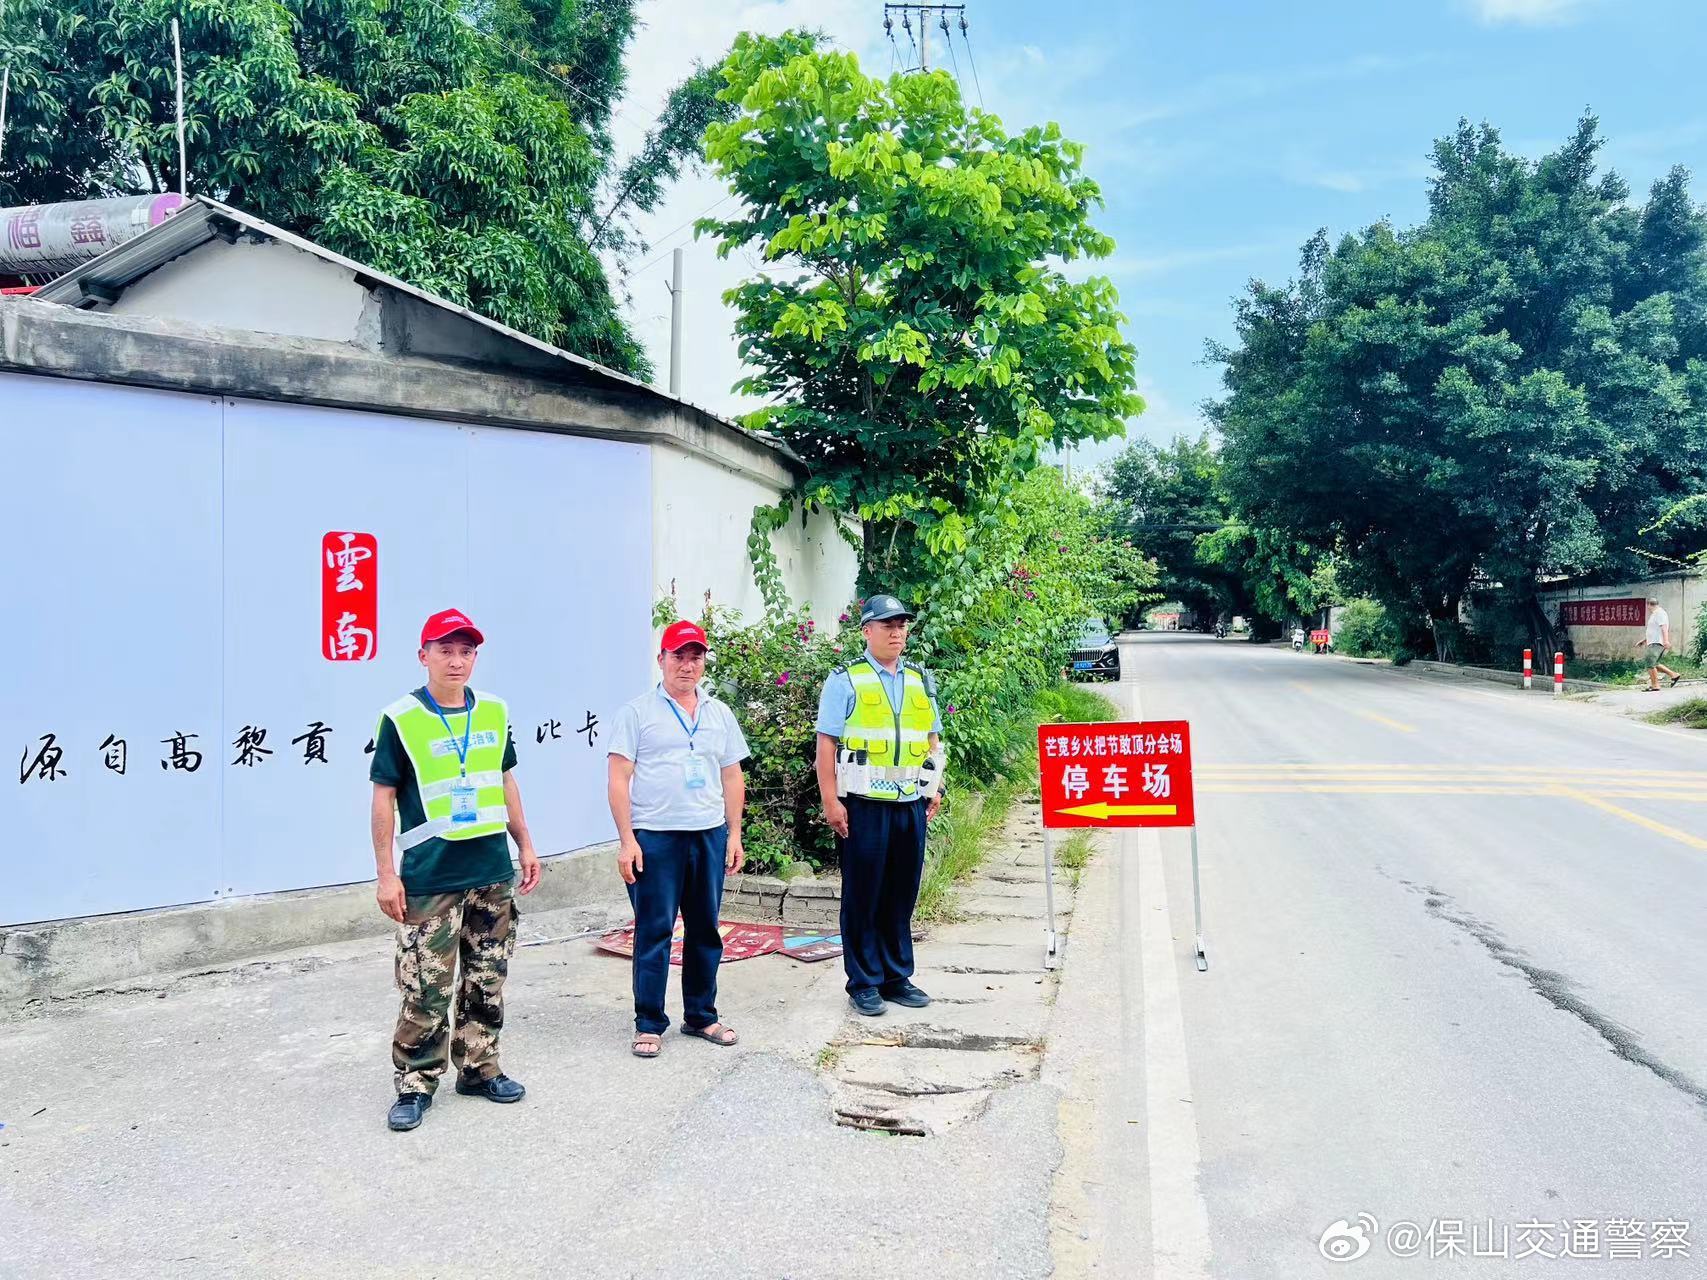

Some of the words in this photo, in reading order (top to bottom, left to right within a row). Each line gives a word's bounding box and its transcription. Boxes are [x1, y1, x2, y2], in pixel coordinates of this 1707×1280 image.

[20, 721, 377, 784] 源自高黎貢
[1045, 733, 1183, 757] 芒宽乡火把节敢顶分会场
[1061, 762, 1171, 800] 停车场
